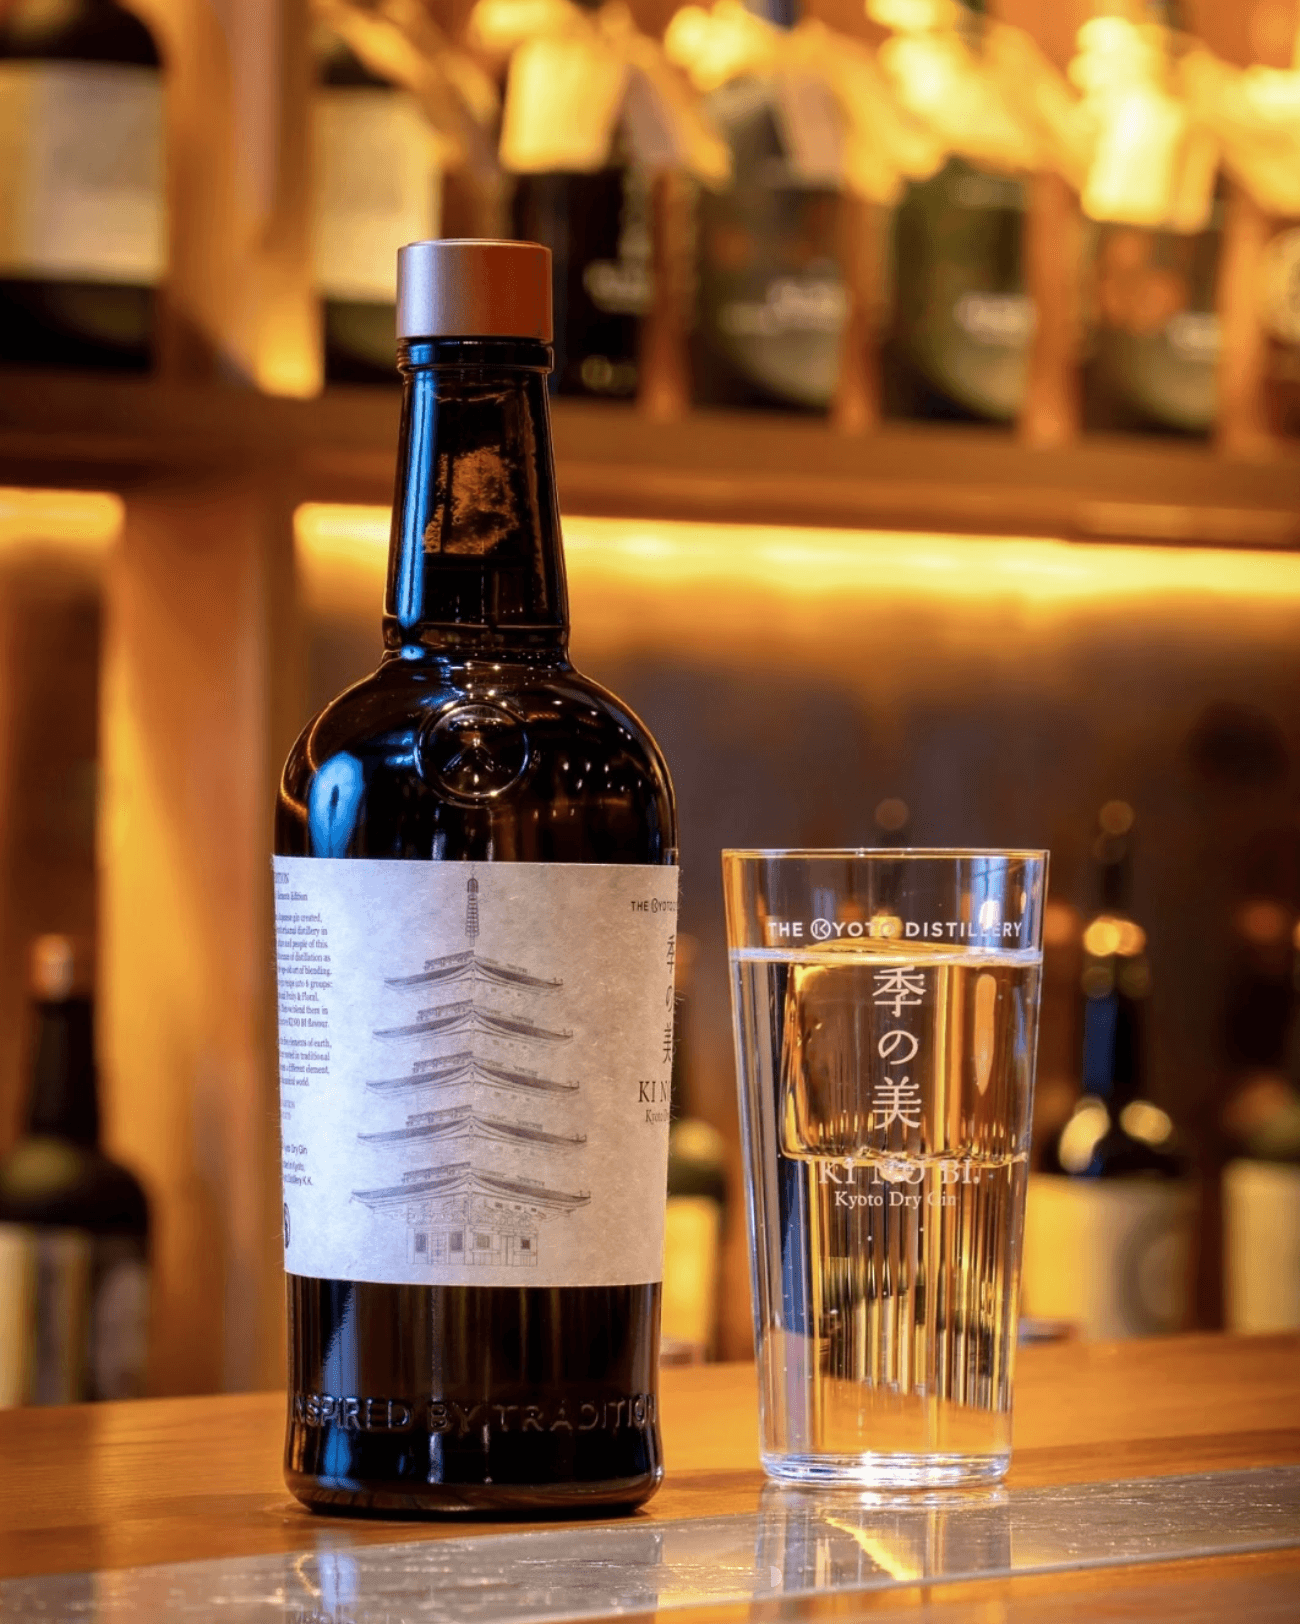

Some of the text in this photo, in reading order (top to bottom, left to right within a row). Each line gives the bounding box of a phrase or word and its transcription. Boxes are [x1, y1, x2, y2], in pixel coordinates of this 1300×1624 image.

[630, 900, 649, 912] THE
[766, 917, 1023, 941] THE KYOTO DISTILLERY
[872, 965, 927, 1130] 季の美
[638, 1080, 656, 1103] KI
[818, 1159, 856, 1184] KI
[834, 1190, 957, 1210] Kyoto Dry Gin
[292, 1394, 411, 1431] NSPIRED
[429, 1402, 483, 1433] BY
